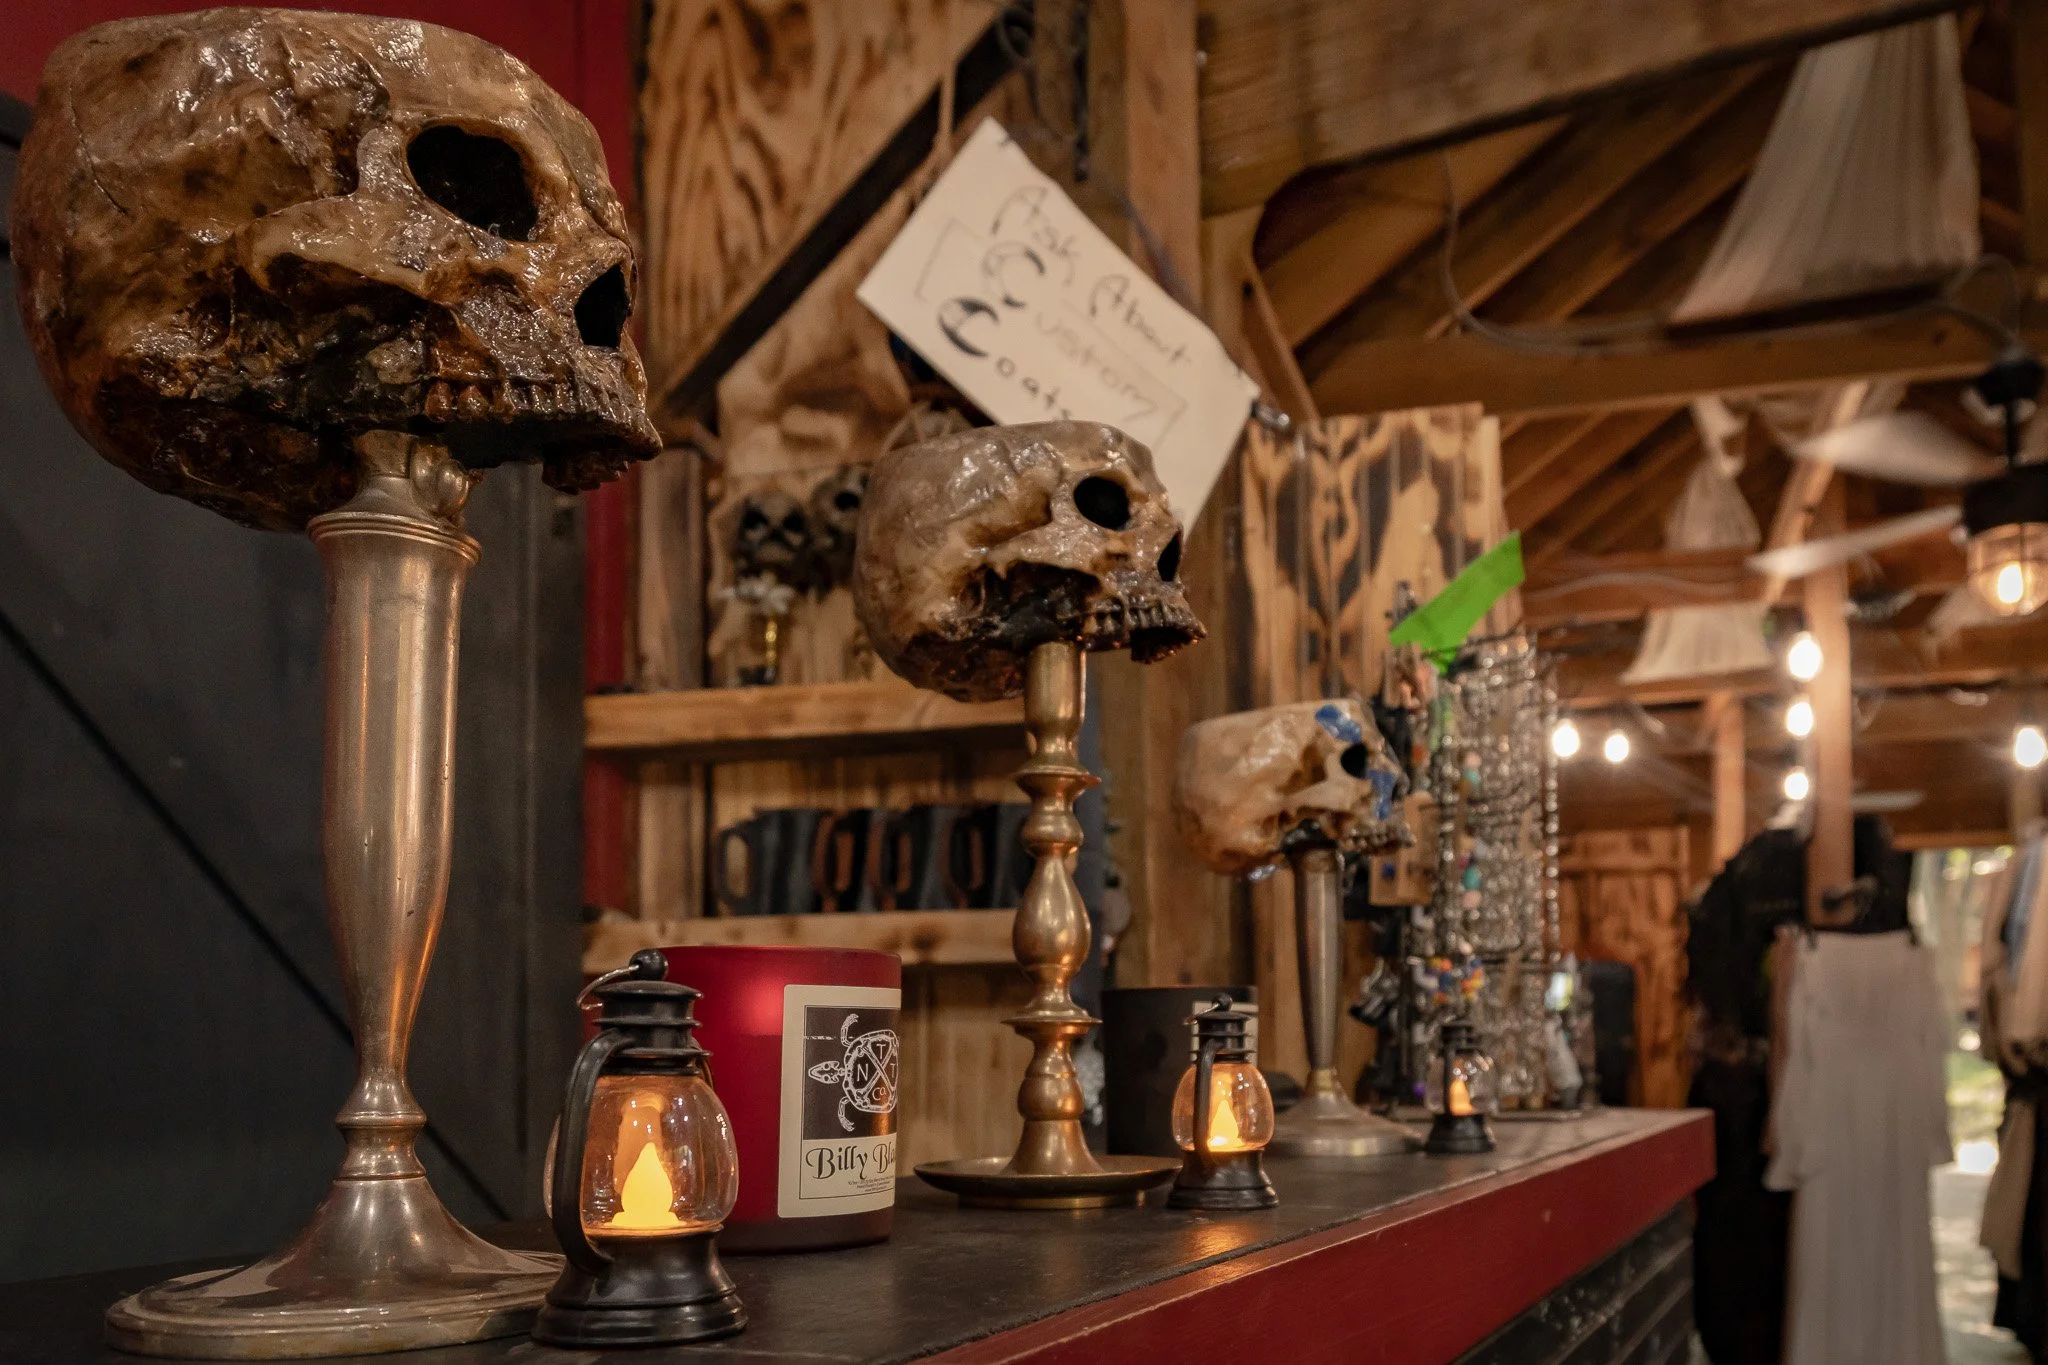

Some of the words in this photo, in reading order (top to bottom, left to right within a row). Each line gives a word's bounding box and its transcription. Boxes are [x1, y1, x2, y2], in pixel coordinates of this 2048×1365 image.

[876, 1043, 887, 1060] T
[857, 1063, 869, 1082] N
[805, 1145, 868, 1180] Billy
